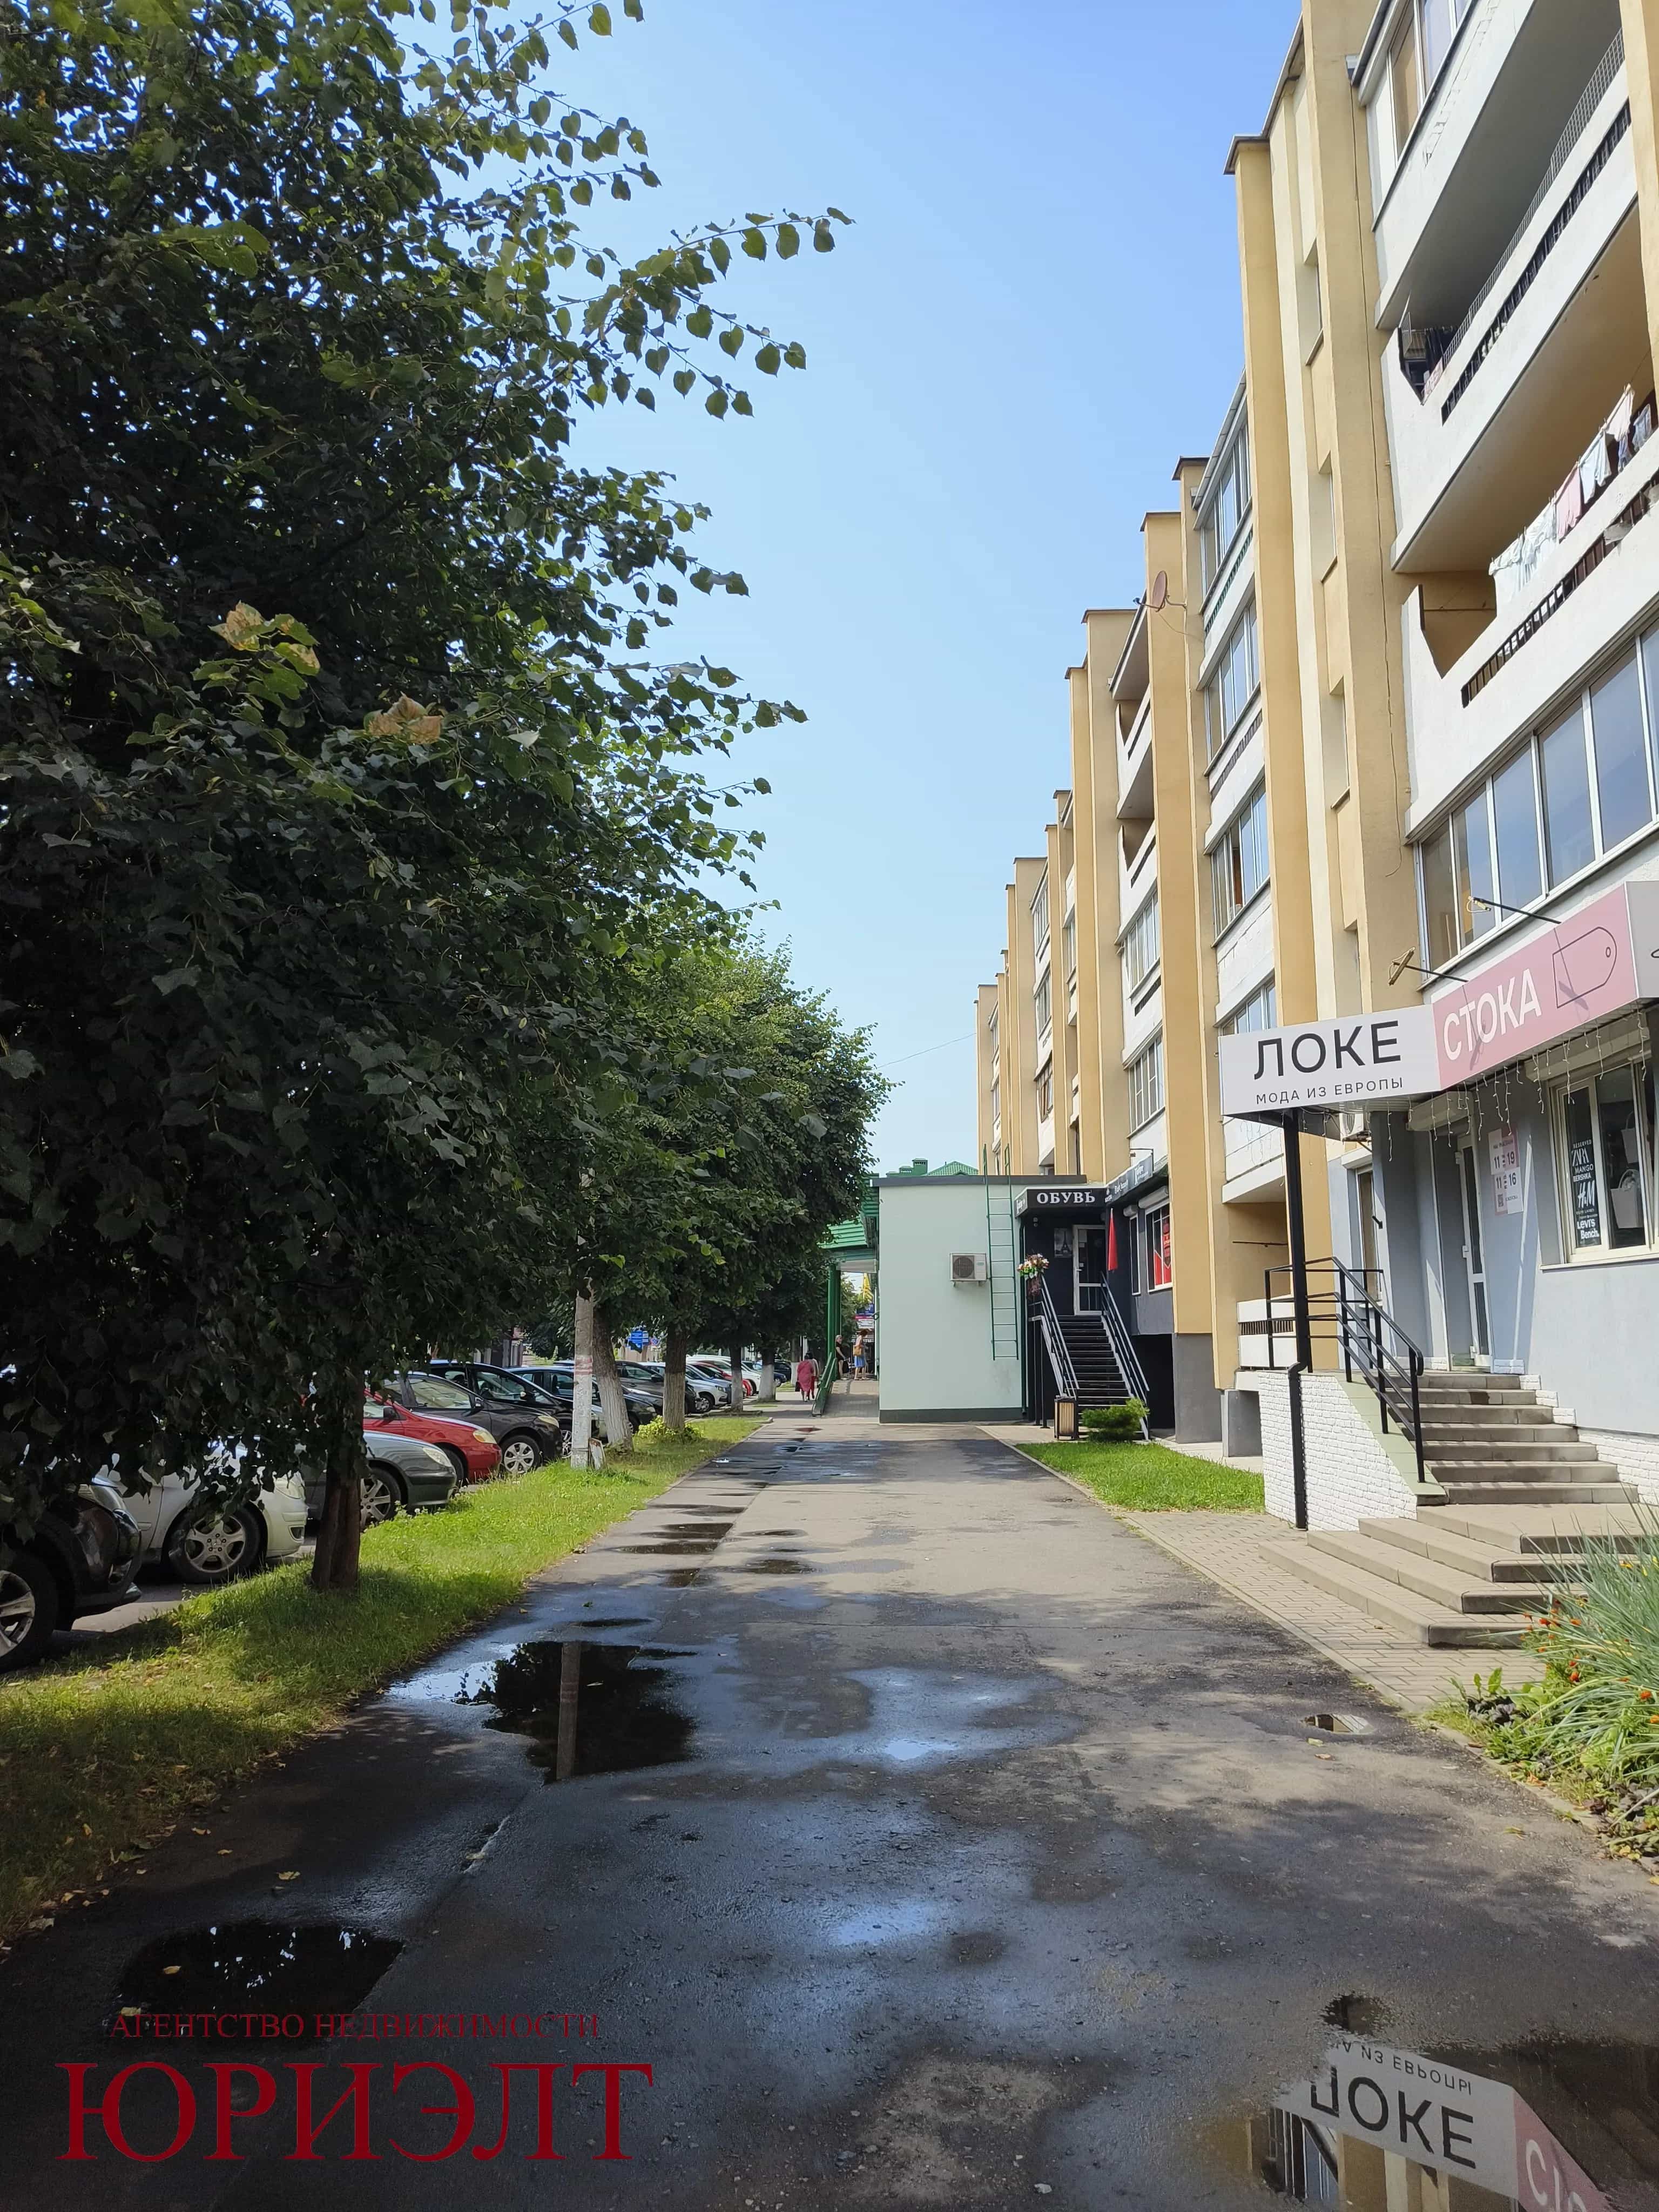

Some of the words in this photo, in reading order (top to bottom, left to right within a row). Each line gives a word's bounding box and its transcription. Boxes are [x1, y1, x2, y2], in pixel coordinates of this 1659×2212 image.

[1442, 968, 1542, 1061] СТОКА
[1254, 1020, 1401, 1080] ЛОКЕ
[1256, 1090, 1300, 1104] МОДА
[1307, 1087, 1326, 1098] ИЗ
[1334, 1077, 1403, 1095] ЕВРОПЫ
[1494, 1155, 1500, 1169] 11
[1507, 1151, 1515, 1165] 19
[1573, 1172, 1591, 1182] BERSHKA
[1575, 1164, 1594, 1174] MANGO
[1496, 1177, 1502, 1189] 11
[1509, 1172, 1517, 1186] 16
[1036, 1192, 1096, 1204] ОБУВЬ
